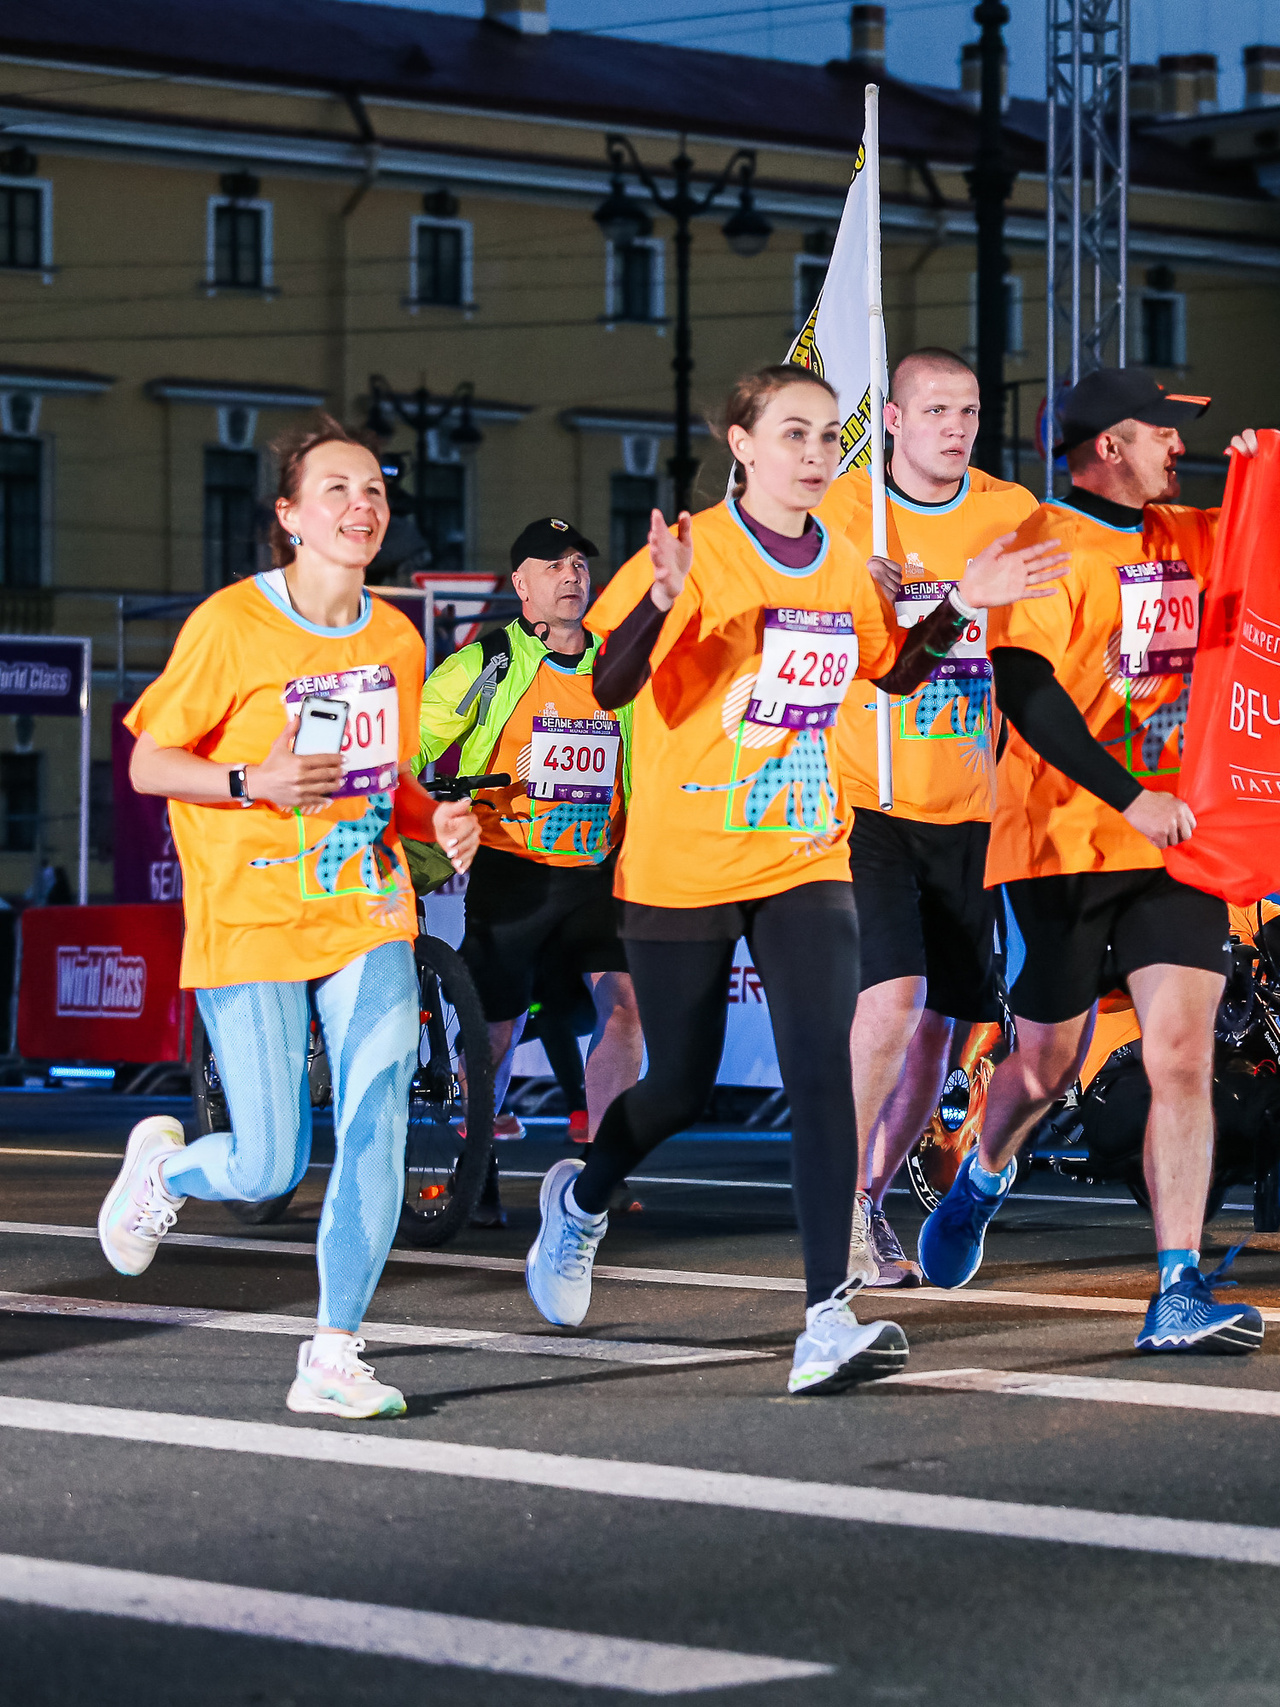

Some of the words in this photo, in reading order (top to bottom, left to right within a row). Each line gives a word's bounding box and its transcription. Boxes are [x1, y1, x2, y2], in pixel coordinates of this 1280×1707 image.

[904, 582, 940, 595] БЕЛЫЕ
[1137, 595, 1195, 634] 4290
[0, 667, 28, 689] orld
[30, 667, 68, 691] Class
[777, 650, 848, 687] 4288
[295, 674, 340, 696] БЕЛЫЕ
[542, 717, 573, 729] БЕЛЫЕ
[586, 719, 614, 731] НОЧИ
[543, 745, 606, 773] 4300
